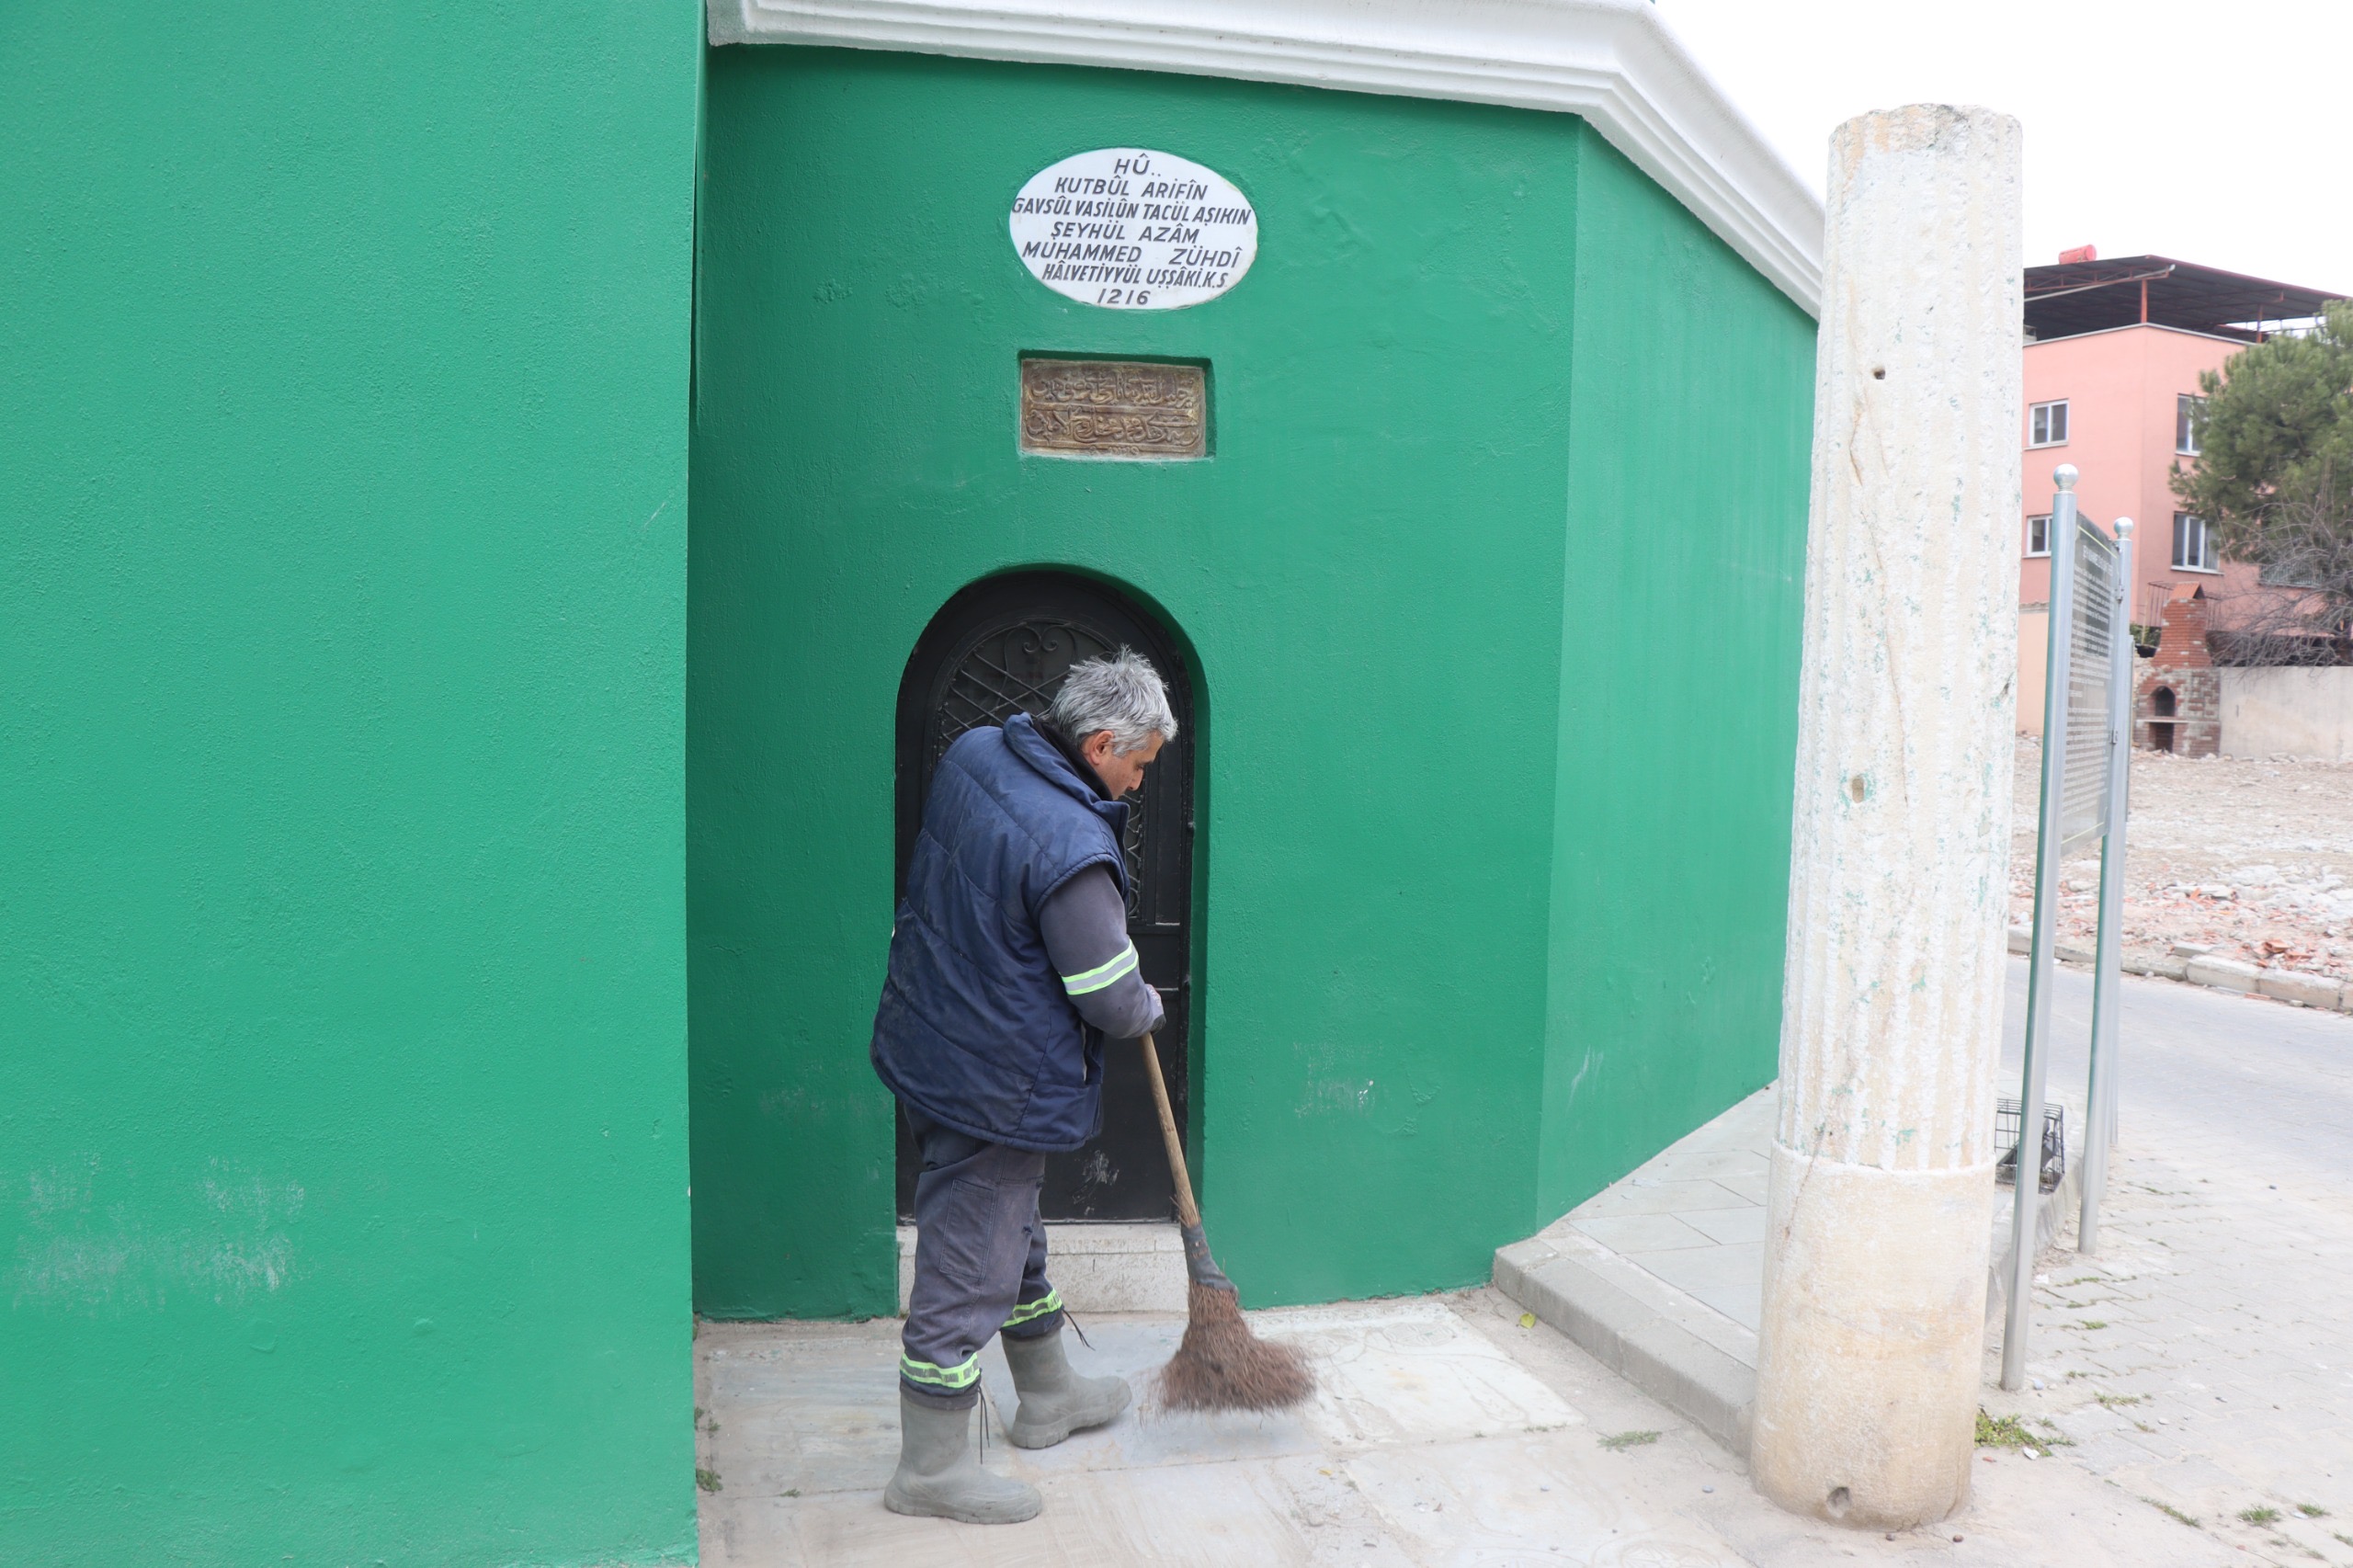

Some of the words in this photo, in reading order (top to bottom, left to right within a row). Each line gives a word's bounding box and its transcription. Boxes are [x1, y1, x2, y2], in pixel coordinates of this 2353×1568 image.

[1054, 175, 1130, 196] KUTBÛL
[1141, 178, 1209, 200] ARİFÎN
[1012, 196, 1072, 216] GAVSÛL
[1074, 198, 1140, 219] VASİLÛN
[1142, 200, 1190, 222] TACÜL
[1192, 206, 1252, 226] AŞIKIN
[1051, 220, 1126, 240] ŞEYHÜL
[1138, 223, 1200, 244] AZÂM
[1022, 242, 1142, 263] MUHAMMED
[1168, 244, 1243, 268] ZÜHDÎ
[1041, 261, 1142, 284] HÂLVETİYYÜL
[1097, 288, 1151, 306] 1216
